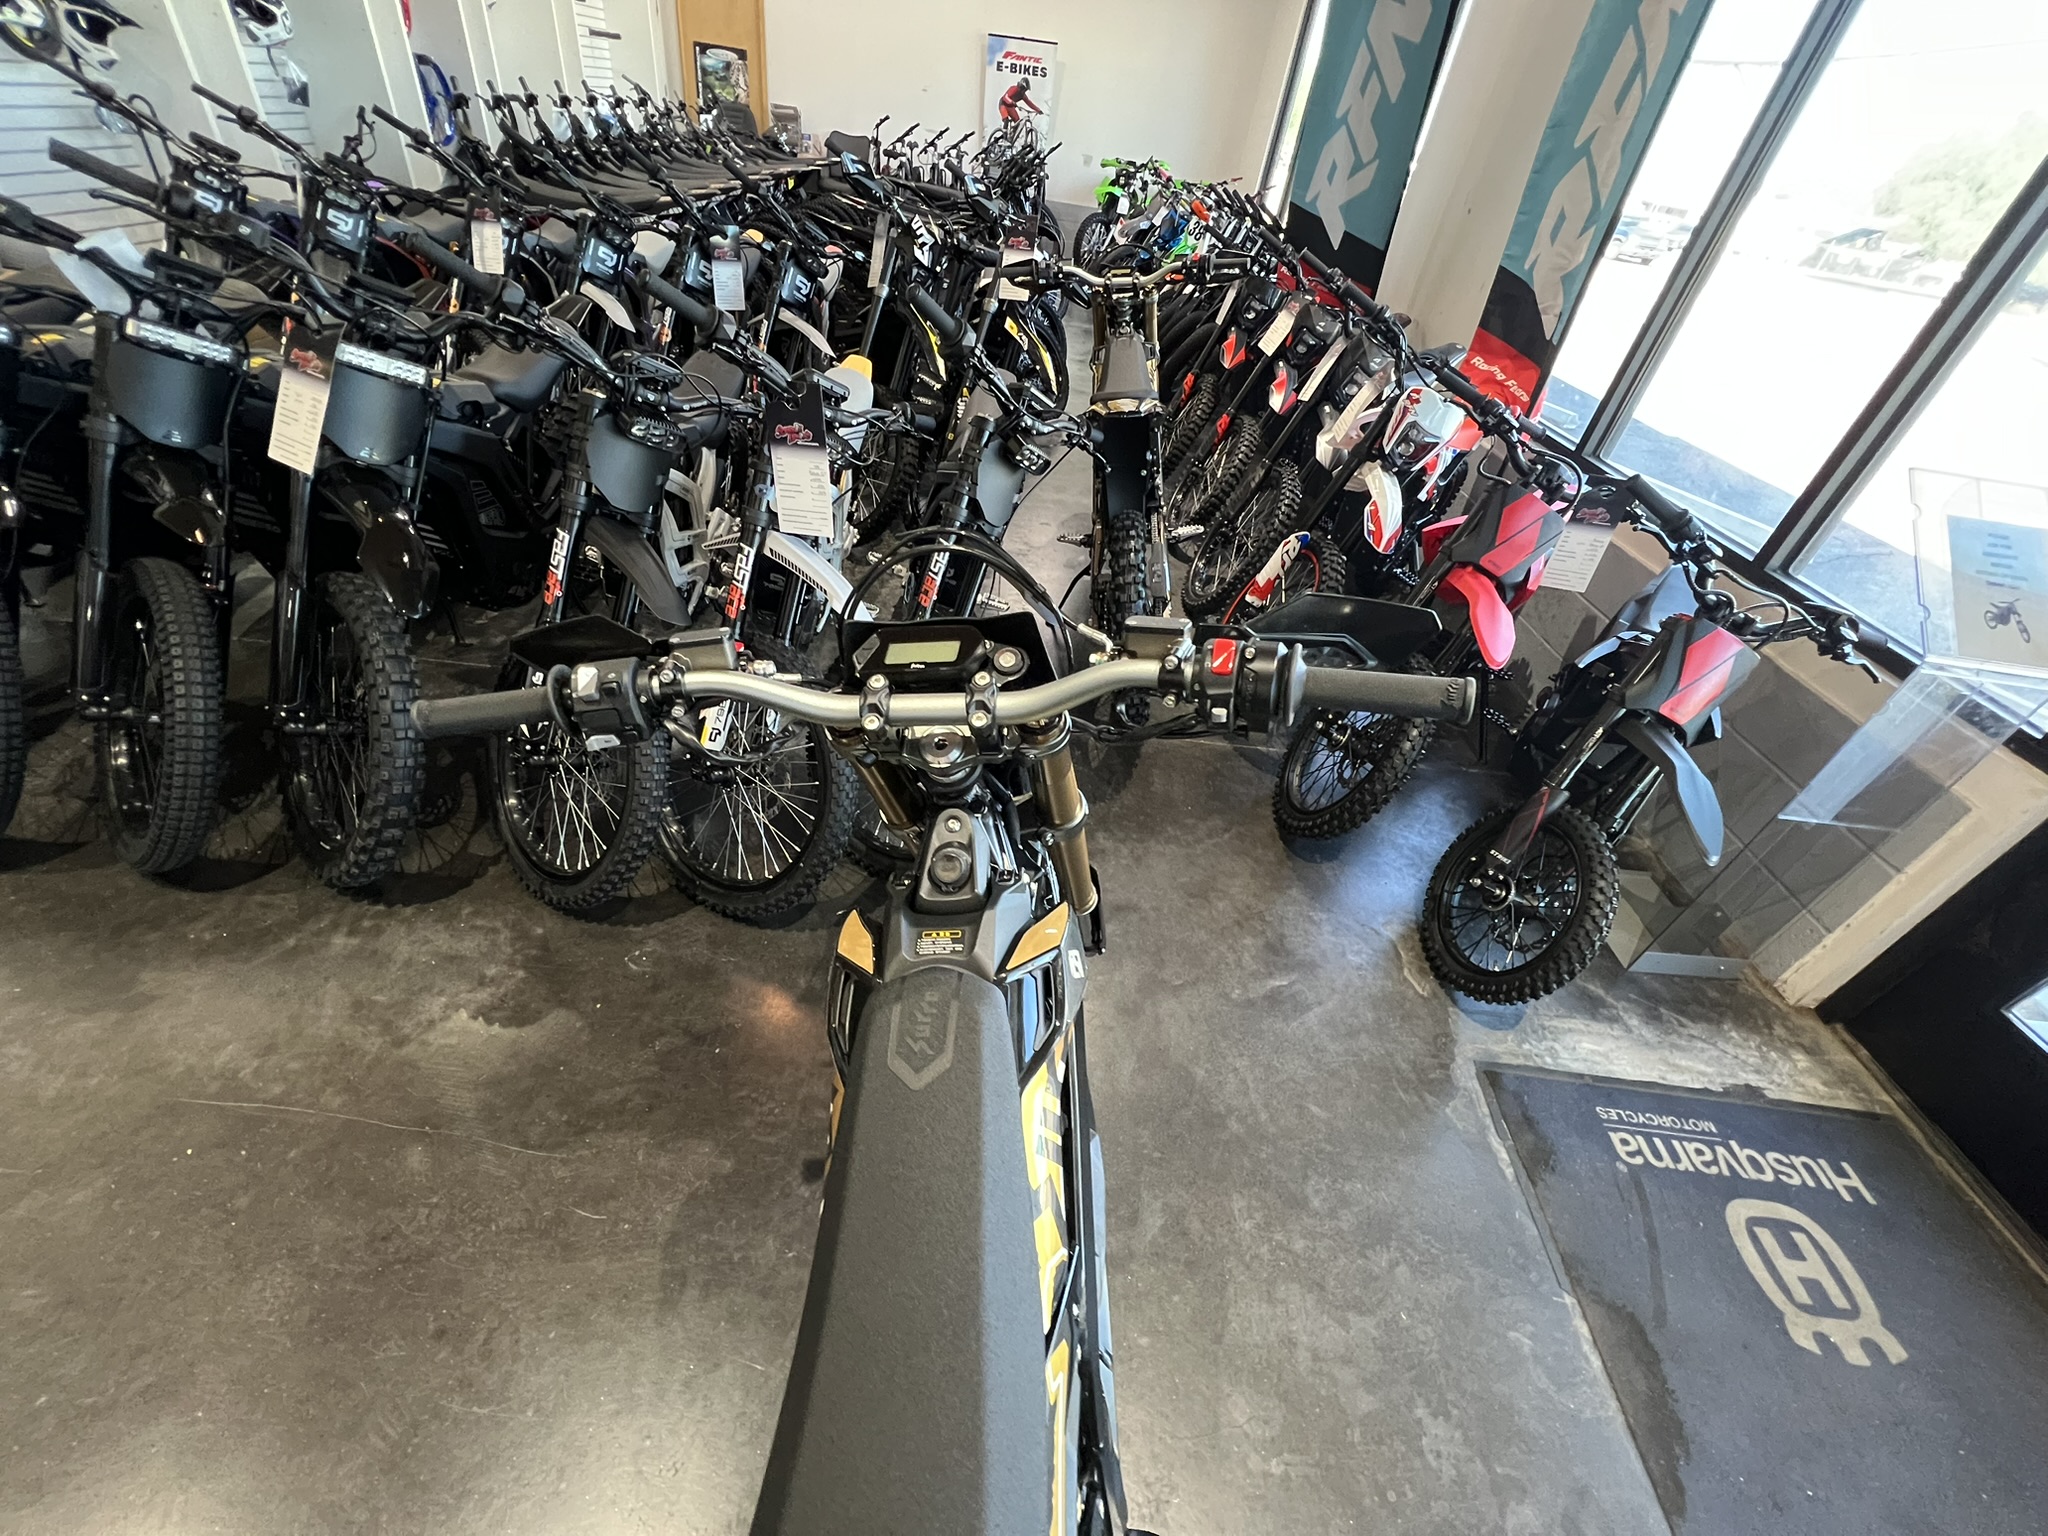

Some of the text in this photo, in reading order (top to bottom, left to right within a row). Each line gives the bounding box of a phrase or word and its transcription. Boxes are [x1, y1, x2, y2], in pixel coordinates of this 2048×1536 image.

[996, 60, 1048, 78] E-BIKES
[1002, 51, 1043, 64] FANTIC
[1470, 356, 1507, 381] Racing
[1595, 1106, 1718, 1133] MOTORCYCLES
[1608, 1131, 1877, 1205] Husqvarna
